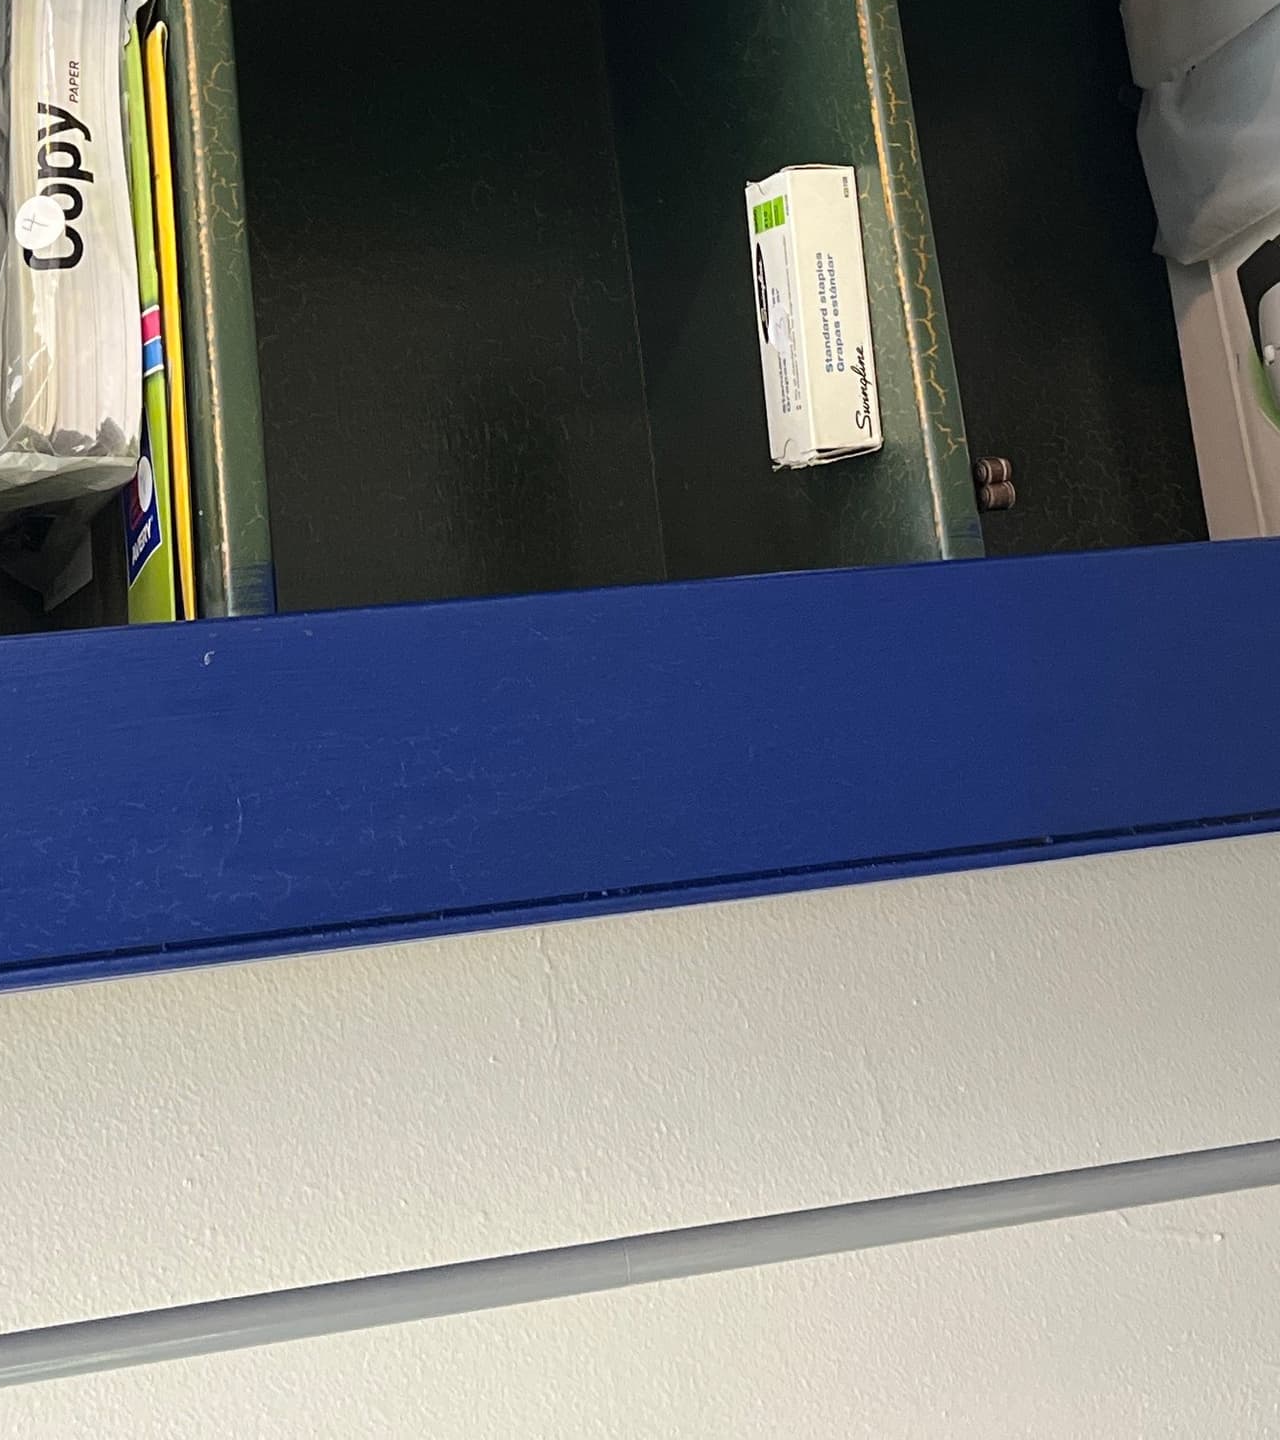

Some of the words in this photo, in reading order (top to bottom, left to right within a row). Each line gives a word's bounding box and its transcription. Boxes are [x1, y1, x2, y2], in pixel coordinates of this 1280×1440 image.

[68, 60, 80, 104] PAPER
[812, 251, 830, 305] staples
[825, 252, 840, 317] estándar
[817, 307, 835, 374] Standard
[831, 319, 846, 374] Grapas
[849, 343, 873, 440] Swingline
[131, 518, 152, 566] AVERY
